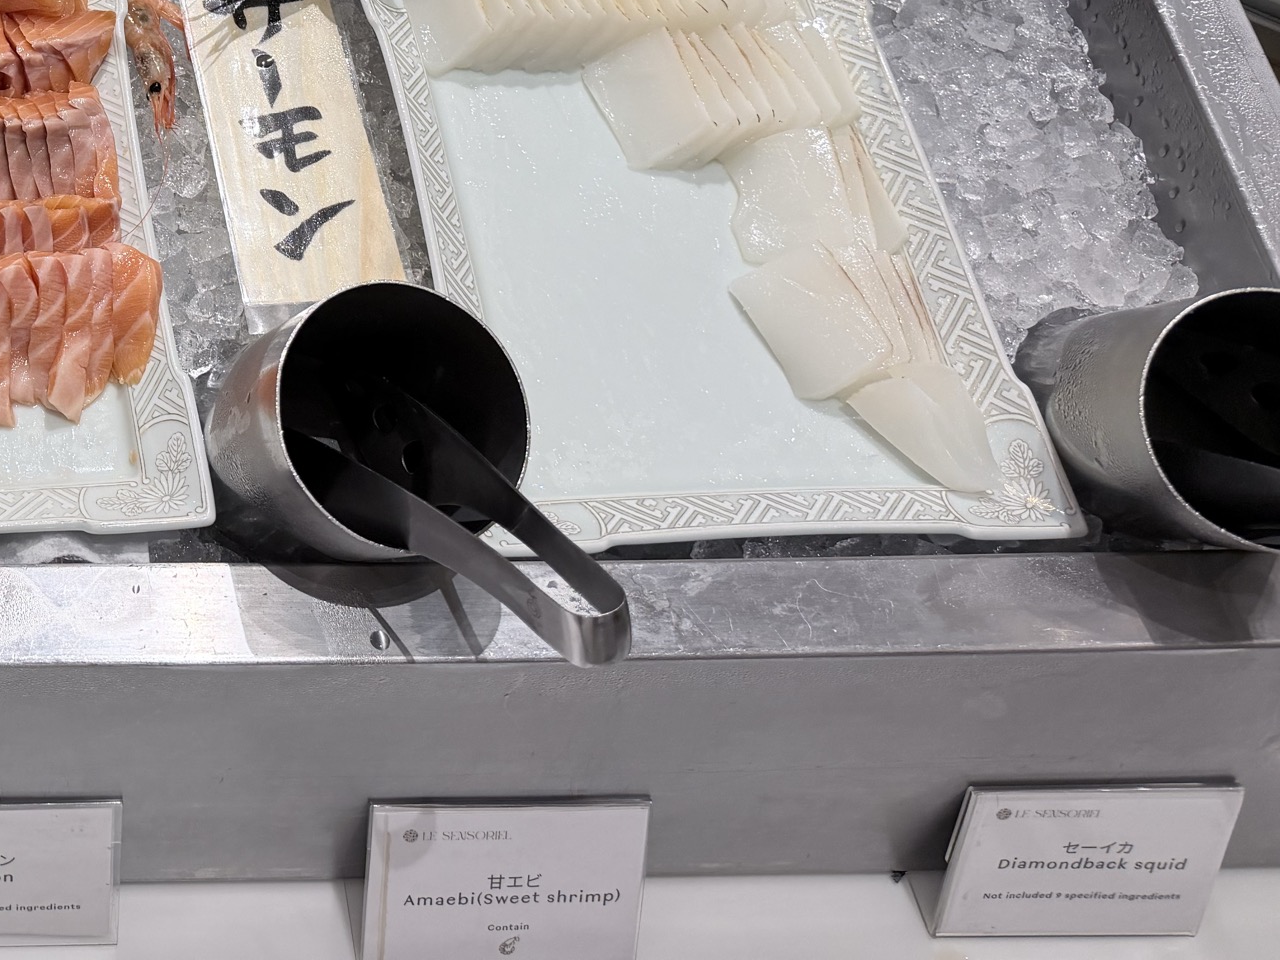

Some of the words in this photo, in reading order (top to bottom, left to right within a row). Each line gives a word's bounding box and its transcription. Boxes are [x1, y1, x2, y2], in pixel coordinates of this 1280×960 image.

[1014, 809, 1032, 818] LE
[422, 831, 437, 840] LE
[1062, 841, 1134, 855] セーイカ
[997, 857, 1126, 871] Diamondback
[1134, 857, 1188, 874] squid
[487, 874, 542, 889] 甘エビ
[403, 891, 540, 906] Amaebi(Sweet
[546, 889, 621, 906] shrimp)
[983, 892, 1003, 900] Not
[1006, 891, 1053, 899] included
[1064, 891, 1115, 901] specified
[1118, 892, 1181, 901] ingredients
[15, 903, 81, 912] ingredients
[488, 923, 529, 931] Contain
